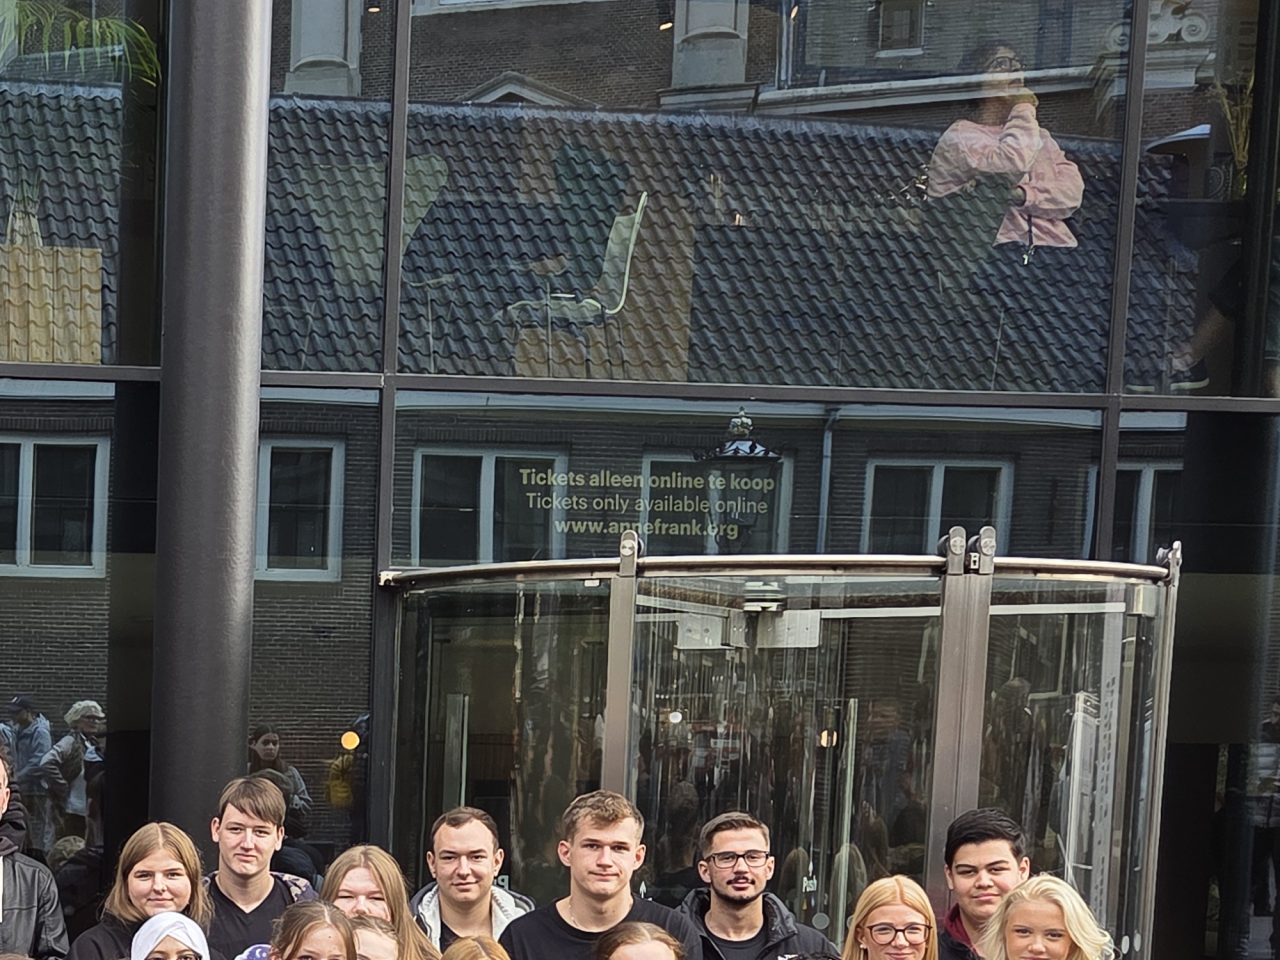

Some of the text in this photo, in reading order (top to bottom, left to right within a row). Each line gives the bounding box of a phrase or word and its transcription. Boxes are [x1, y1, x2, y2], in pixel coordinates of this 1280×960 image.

[519, 468, 775, 494] Tickets alleen online te koop
[526, 493, 768, 515] Tickets only available online
[554, 518, 739, 539] www.annefrank.org
